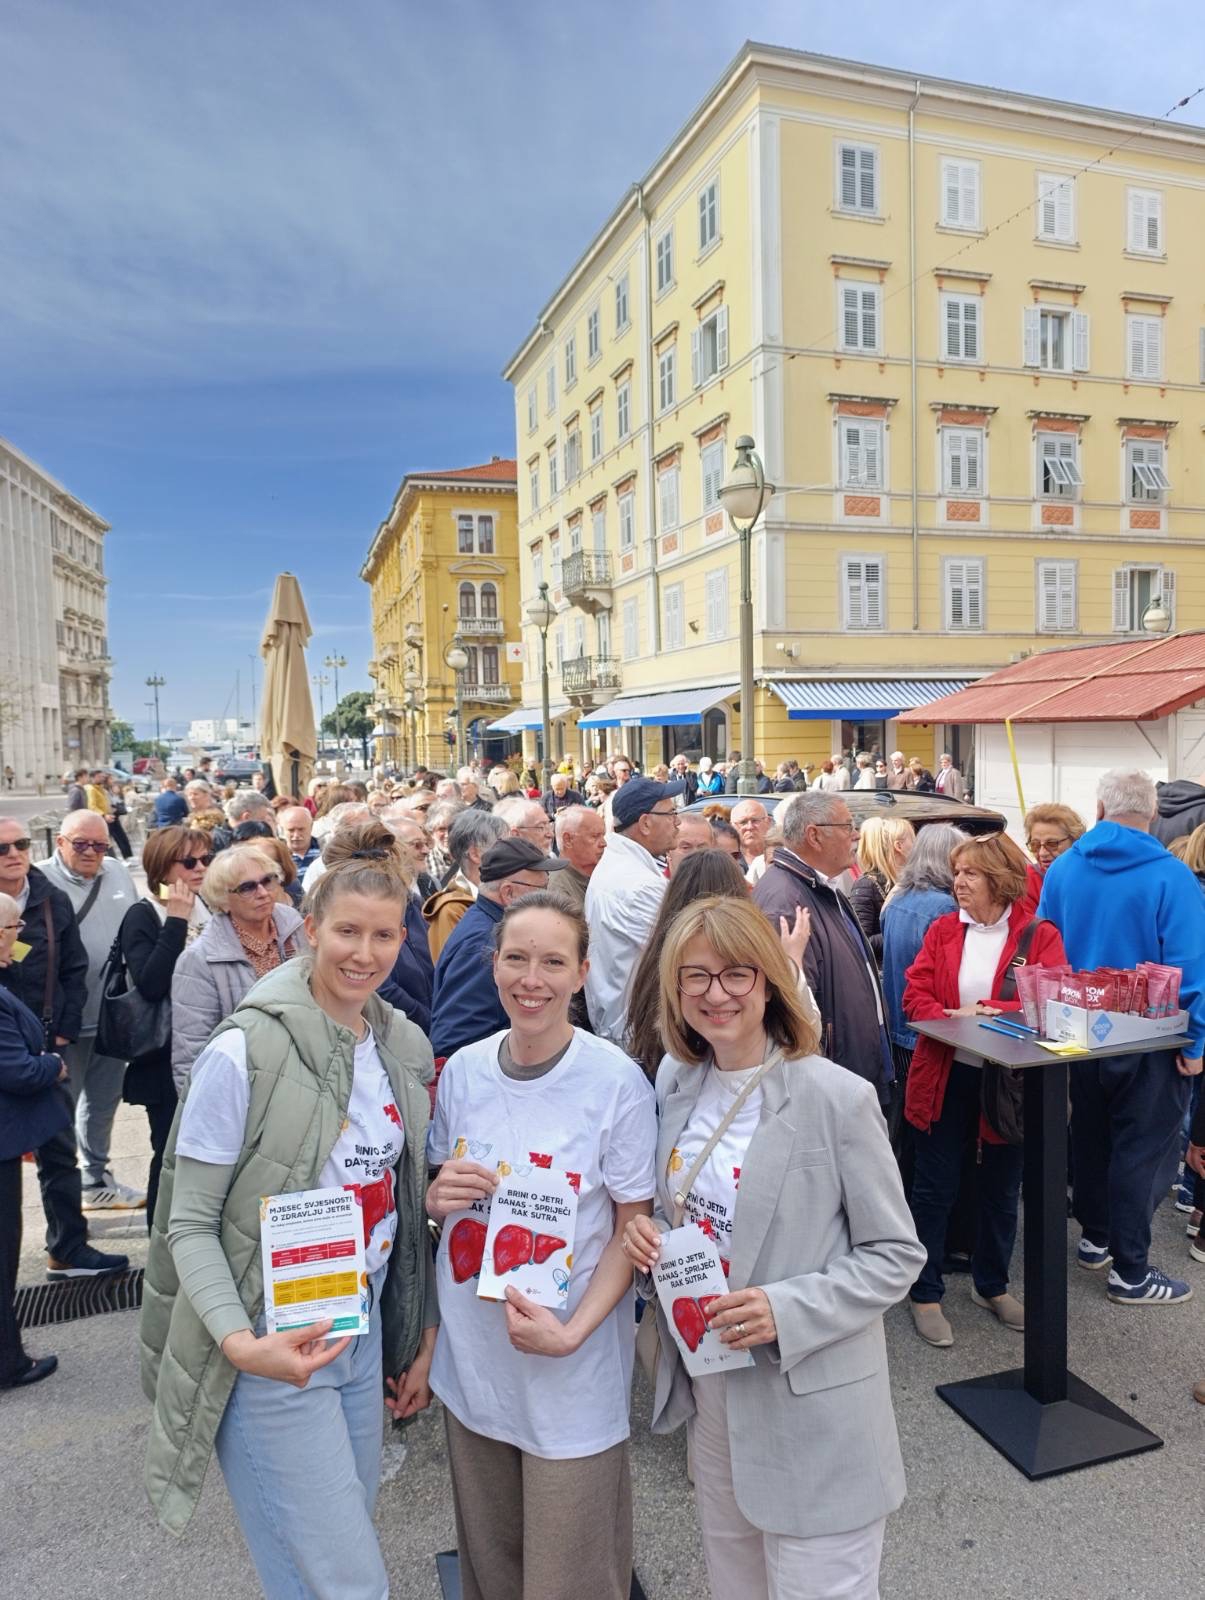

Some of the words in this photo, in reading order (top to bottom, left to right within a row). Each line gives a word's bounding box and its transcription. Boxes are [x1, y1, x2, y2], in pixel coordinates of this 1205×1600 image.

[269, 1203, 302, 1215] MJESEC
[304, 1195, 353, 1209] SVJESNOSTI
[498, 1197, 526, 1209] DANAS
[534, 1203, 571, 1217] SPRIJEČI
[507, 1189, 529, 1200] BRINI
[530, 1193, 538, 1201] O
[539, 1195, 564, 1206] JETRI
[699, 1197, 705, 1207] O
[706, 1200, 727, 1217] JETRI
[271, 1215, 279, 1223] O
[281, 1208, 323, 1221] ZDRAVLJU
[325, 1204, 351, 1215] JETRE
[511, 1207, 528, 1218] RAK
[530, 1211, 558, 1223] SUTRA
[657, 1270, 679, 1283] DANAS
[684, 1258, 716, 1276] SPRIJEČI
[660, 1259, 677, 1271] BRINI
[677, 1257, 684, 1266] O
[685, 1251, 706, 1264] JETRI
[670, 1278, 684, 1289] RAK
[684, 1272, 708, 1285] SUTRA
